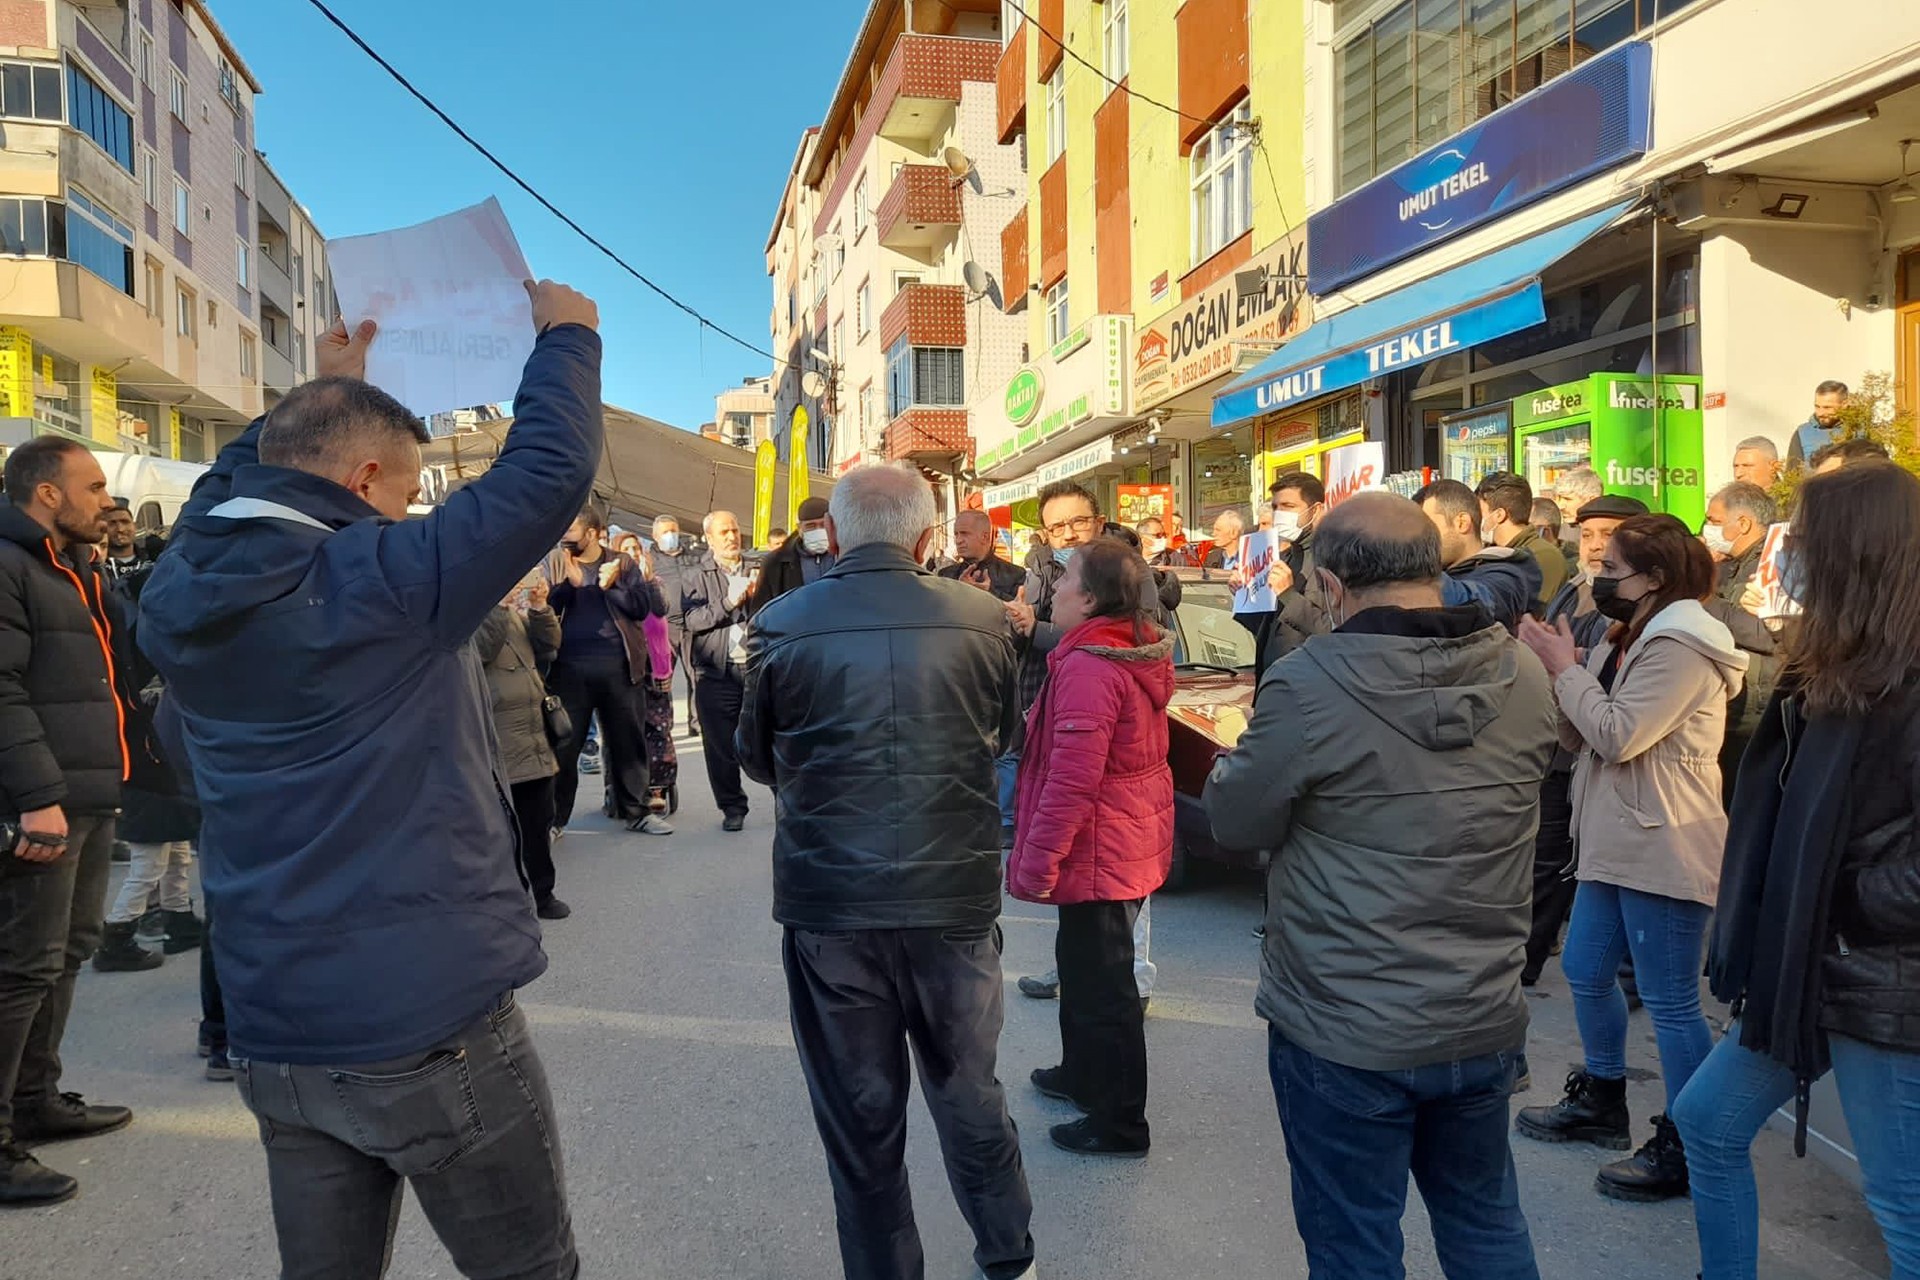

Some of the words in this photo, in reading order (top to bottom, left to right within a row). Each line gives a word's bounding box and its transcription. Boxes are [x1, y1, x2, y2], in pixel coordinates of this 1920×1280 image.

[1399, 184, 1439, 221] UMUT
[1441, 162, 1490, 200] TEKEL
[1170, 287, 1231, 363] DOĞAN
[1182, 361, 1198, 386] 0532
[1199, 354, 1211, 378] 620
[1223, 343, 1232, 366] 30
[1256, 365, 1326, 409] UMUT
[1364, 321, 1460, 372] TEKEL
[1532, 392, 1582, 416] fusetea
[1471, 422, 1498, 440] pepsi
[1606, 459, 1698, 487] fusetea
